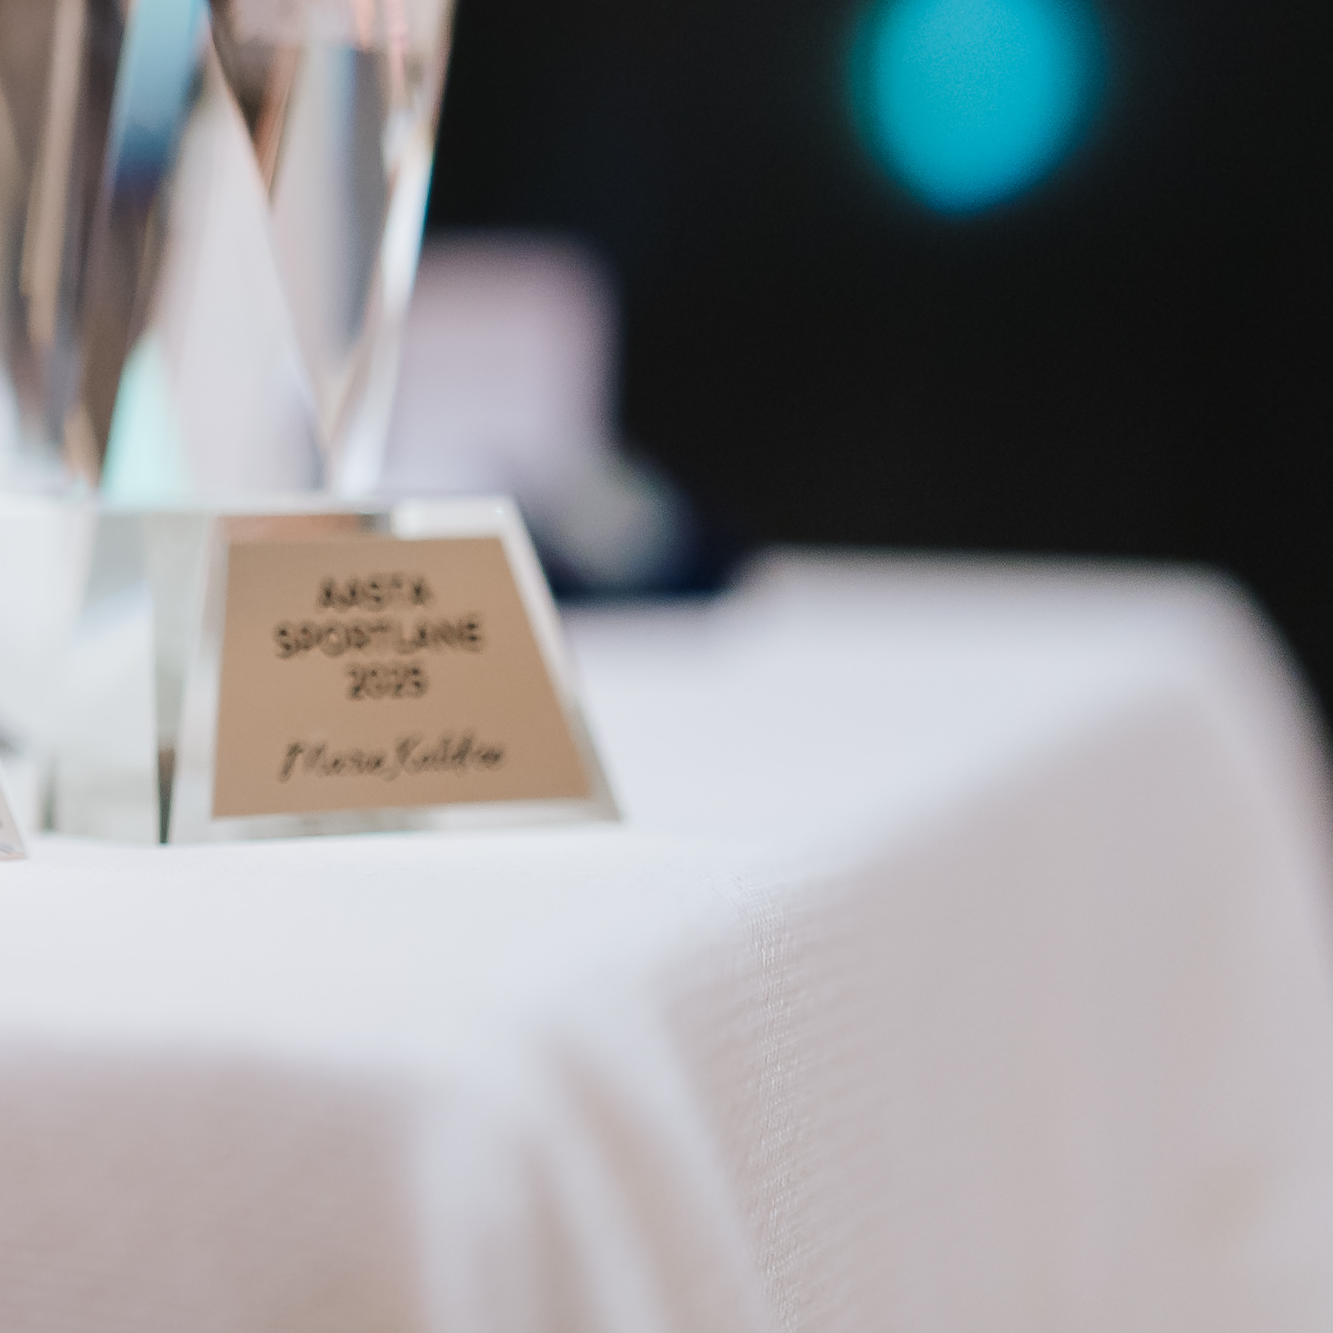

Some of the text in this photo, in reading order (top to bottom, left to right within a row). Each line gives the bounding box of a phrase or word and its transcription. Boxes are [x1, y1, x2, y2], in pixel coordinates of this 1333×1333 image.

[316, 572, 431, 611] AASTA
[273, 610, 483, 658] SPORTLANE
[347, 663, 427, 701] 2025
